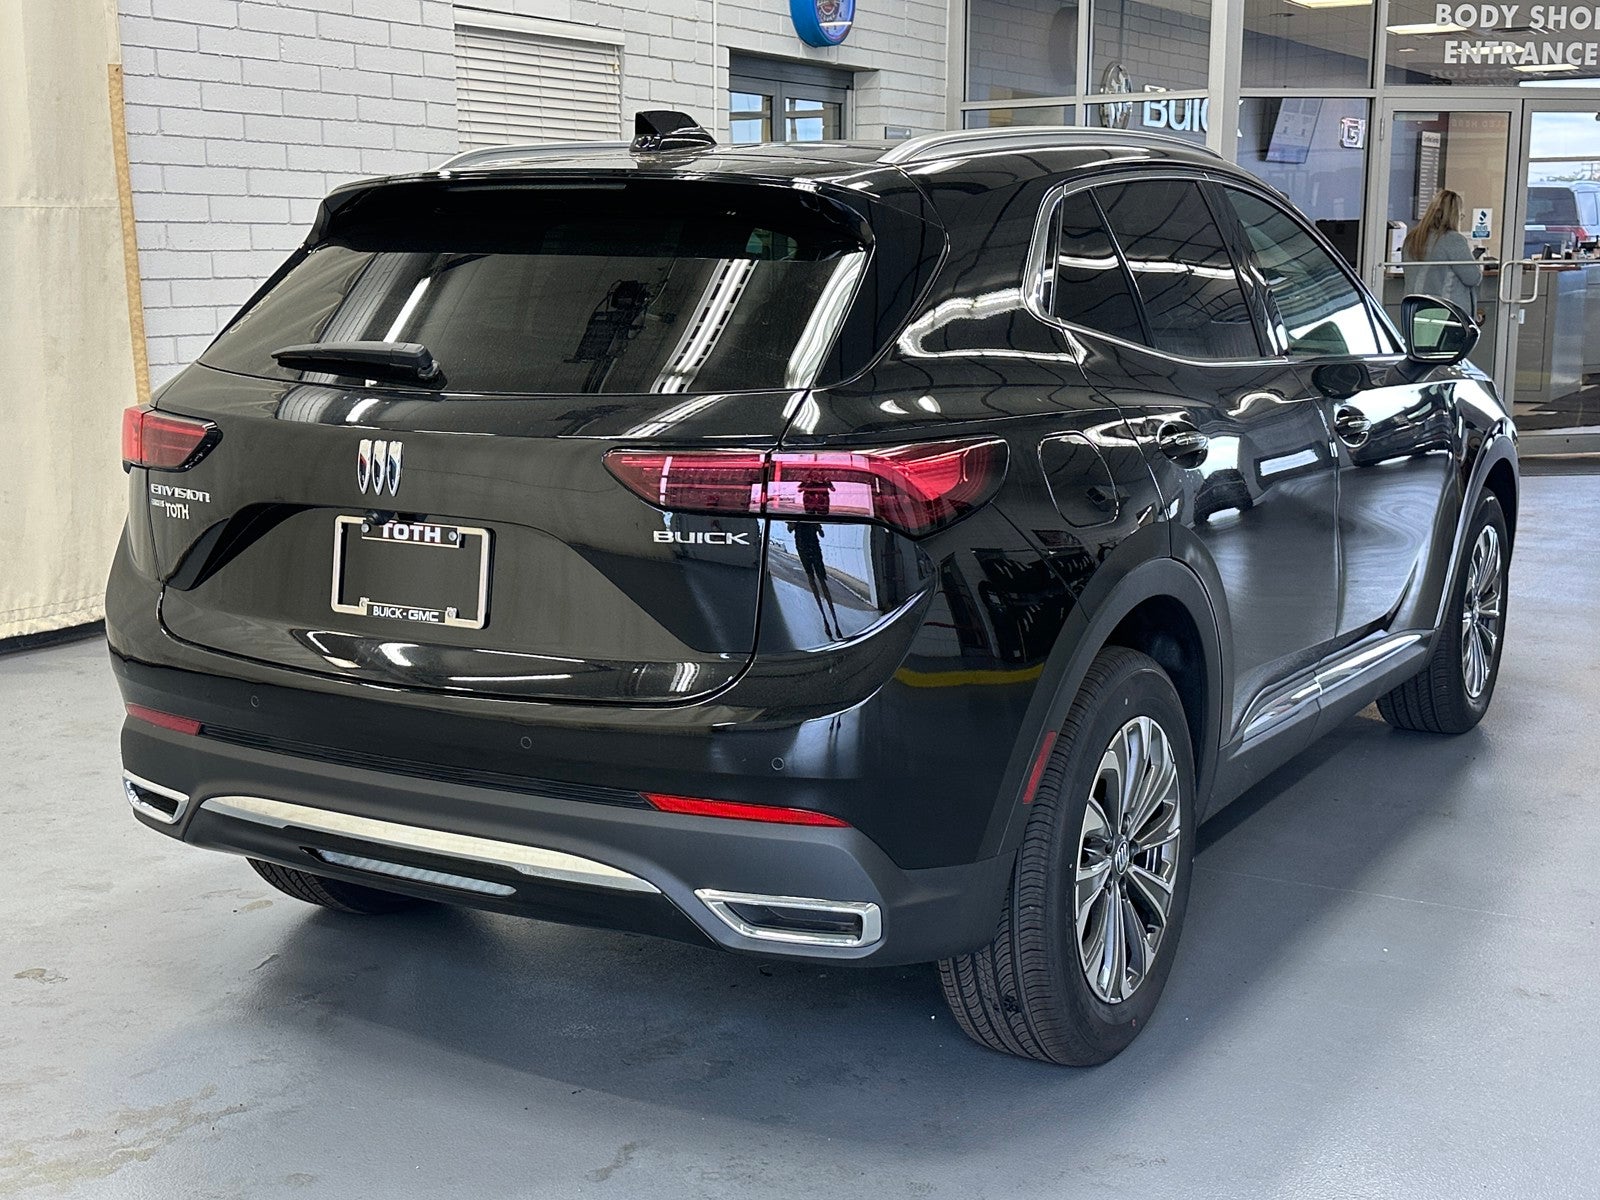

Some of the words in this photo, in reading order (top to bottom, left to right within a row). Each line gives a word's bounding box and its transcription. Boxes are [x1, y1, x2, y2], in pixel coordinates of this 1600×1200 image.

[1436, 4, 1519, 28] BODY
[1444, 40, 1598, 66] ENTRANCE
[165, 501, 190, 520] TOTH
[382, 522, 442, 543] TOTH
[653, 530, 750, 545] BUICK
